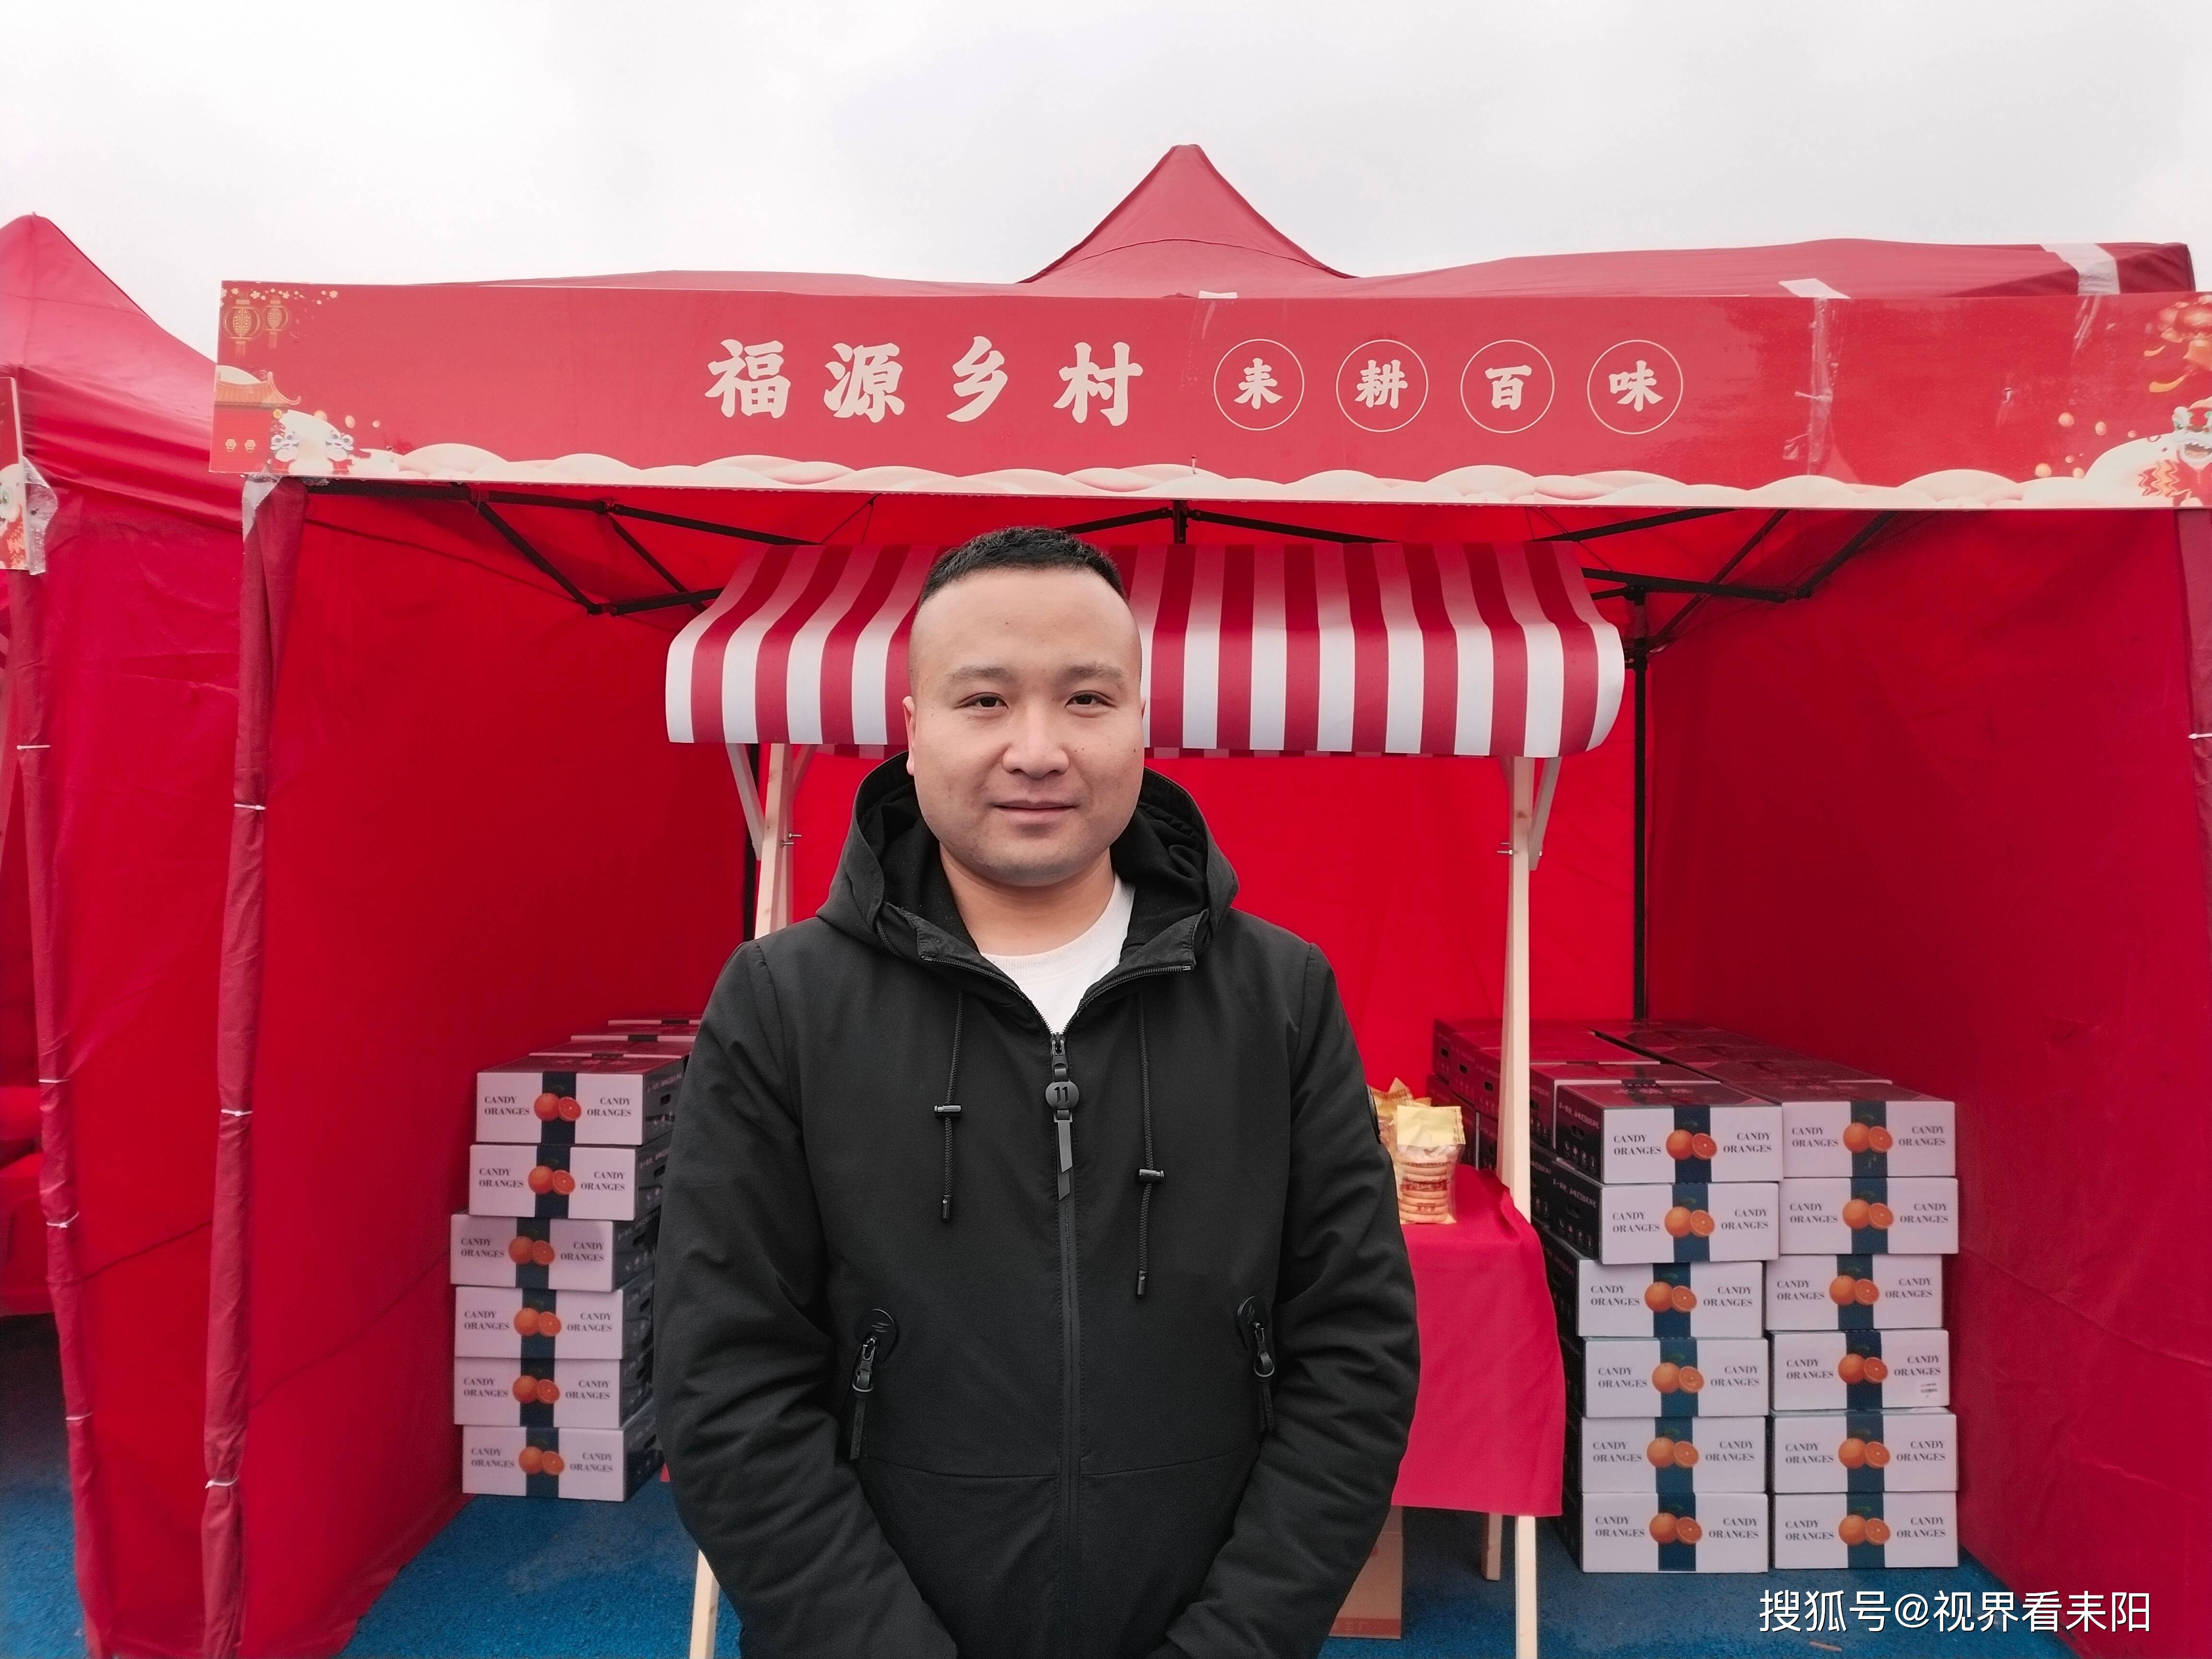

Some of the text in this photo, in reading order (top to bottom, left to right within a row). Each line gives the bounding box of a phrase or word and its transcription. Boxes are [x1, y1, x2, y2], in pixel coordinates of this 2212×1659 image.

[705, 336, 1143, 426] 福源乡村
[1054, 1086, 1069, 1104] 11
[587, 1109, 631, 1117] ORANGES
[1791, 1127, 1824, 1135] CANDY
[1911, 1126, 1945, 1134] CANDY
[1614, 1135, 1647, 1143] CANDY
[1737, 1132, 1771, 1141] CANDY
[1791, 1138, 1839, 1147] ORANGES
[1899, 1138, 1946, 1146] ORANGES
[1614, 1146, 1661, 1155] ORANGES
[1723, 1144, 1772, 1153] ORANGES
[594, 1171, 625, 1179] CANDY
[479, 1179, 524, 1188] ORANGES
[581, 1182, 625, 1190] ORANGES
[1790, 1203, 1823, 1211] CANDY
[1913, 1202, 1947, 1211] CANDY
[1612, 1212, 1645, 1220] CANDY
[1735, 1209, 1767, 1217] CANDY
[1790, 1215, 1838, 1224] ORANGES
[1899, 1215, 1948, 1223] ORANGES
[1612, 1224, 1660, 1232] ORANGES
[1721, 1221, 1769, 1229] ORANGES
[461, 1238, 492, 1246] CANDY
[573, 1242, 604, 1250] CANDY
[461, 1249, 504, 1257] ORANGES
[560, 1253, 604, 1261] ORANGES
[1777, 1280, 1810, 1288] CANDY
[1899, 1277, 1931, 1286] CANDY
[1590, 1285, 1624, 1294] CANDY
[1718, 1286, 1752, 1294] CANDY
[1777, 1292, 1825, 1300] ORANGES
[1885, 1290, 1933, 1298] ORANGES
[1590, 1298, 1640, 1306] ORANGES
[1703, 1298, 1753, 1307] ORANGES
[464, 1310, 497, 1319] CANDY
[1787, 1359, 1819, 1368] CANDY
[1907, 1355, 1940, 1364] CANDY
[1724, 1366, 1758, 1374] CANDY
[1894, 1367, 1941, 1376] ORANGES
[1786, 1370, 1834, 1379] ORANGES
[1598, 1379, 1647, 1388] ORANGES
[1710, 1378, 1759, 1386] ORANGES
[565, 1391, 610, 1399] ORANGES
[1593, 1441, 1627, 1450] CANDY
[1719, 1441, 1754, 1449] CANDY
[1785, 1443, 1819, 1451] CANDY
[1910, 1441, 1945, 1449] CANDY
[471, 1448, 502, 1456] CANDY
[582, 1453, 613, 1461] CANDY
[1593, 1454, 1642, 1462] ORANGES
[1705, 1453, 1755, 1461] ORANGES
[1785, 1455, 1834, 1464] ORANGES
[1896, 1452, 1946, 1461] ORANGES
[471, 1459, 515, 1467] ORANGES
[569, 1463, 613, 1472] ORANGES
[1595, 1516, 1630, 1525] CANDY
[1723, 1517, 1757, 1526] CANDY
[1785, 1520, 1819, 1528] CANDY
[1911, 1517, 1945, 1525] CANDY
[1595, 1528, 1645, 1537] ORANGES
[1708, 1529, 1758, 1539] ORANGES
[1785, 1531, 1834, 1540] ORANGES
[1897, 1528, 1946, 1538] ORANGES
